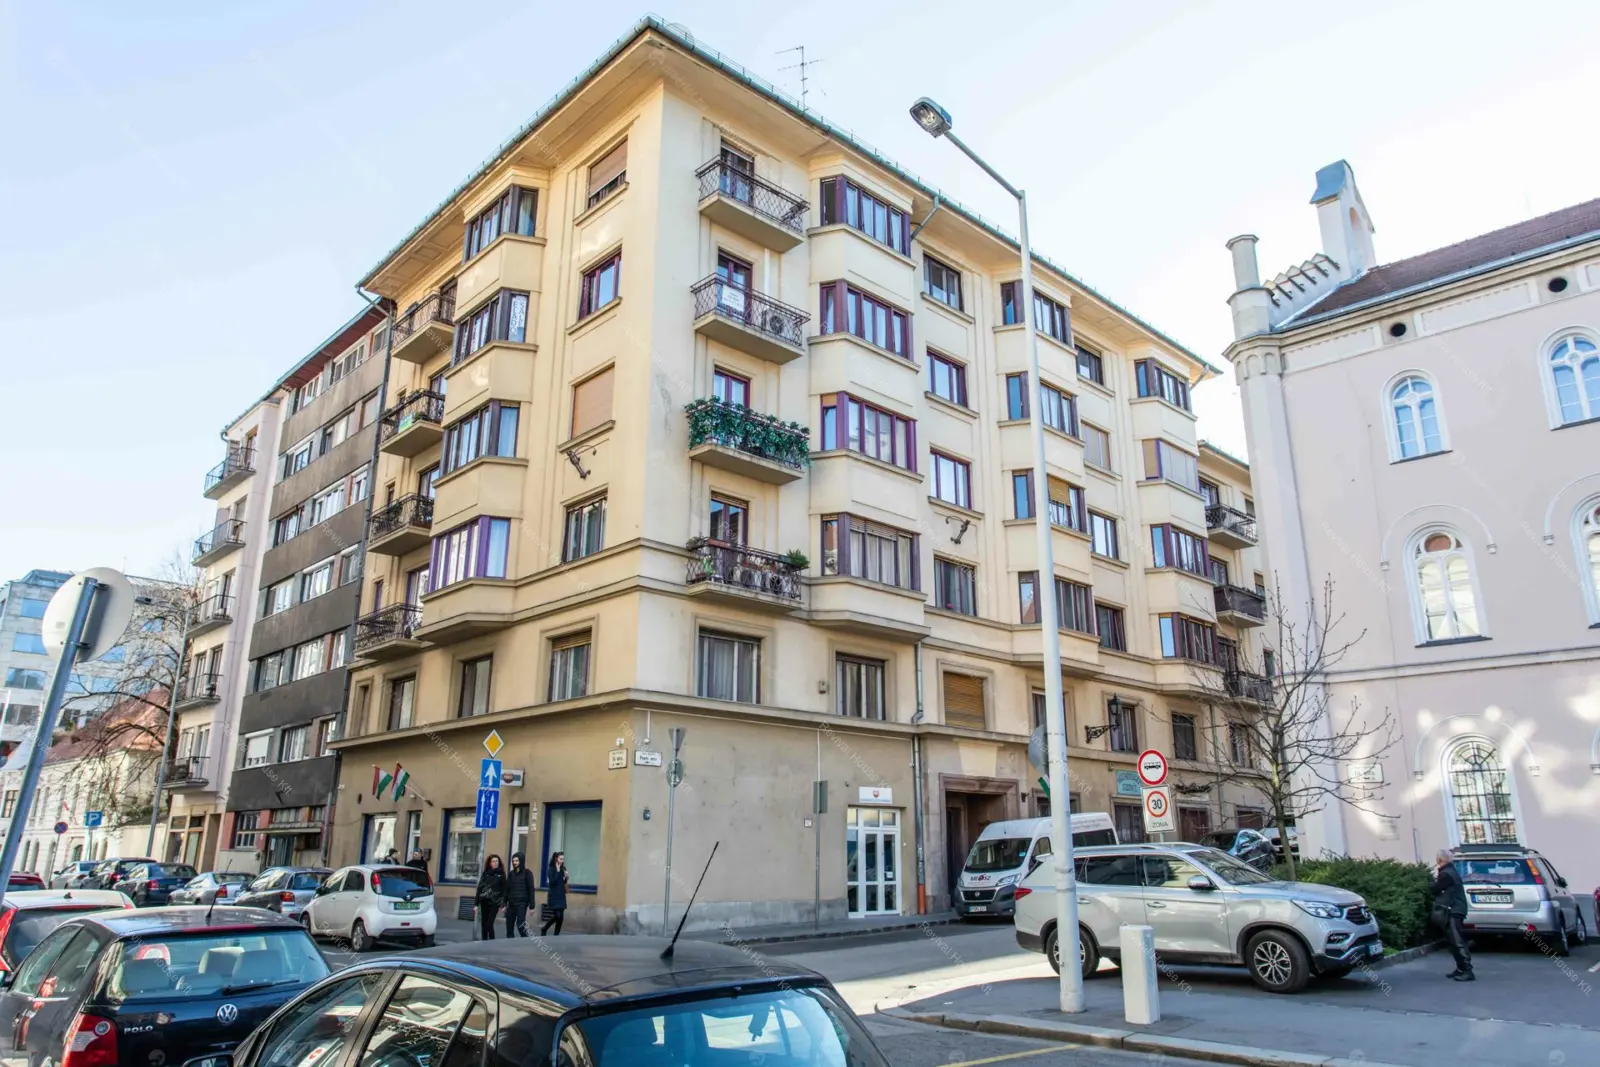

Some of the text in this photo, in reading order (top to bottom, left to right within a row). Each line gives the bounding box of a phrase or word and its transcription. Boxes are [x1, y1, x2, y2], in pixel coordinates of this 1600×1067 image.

[1151, 799, 1163, 810] 30
[88, 813, 99, 825] P
[124, 1025, 153, 1035] POLO
